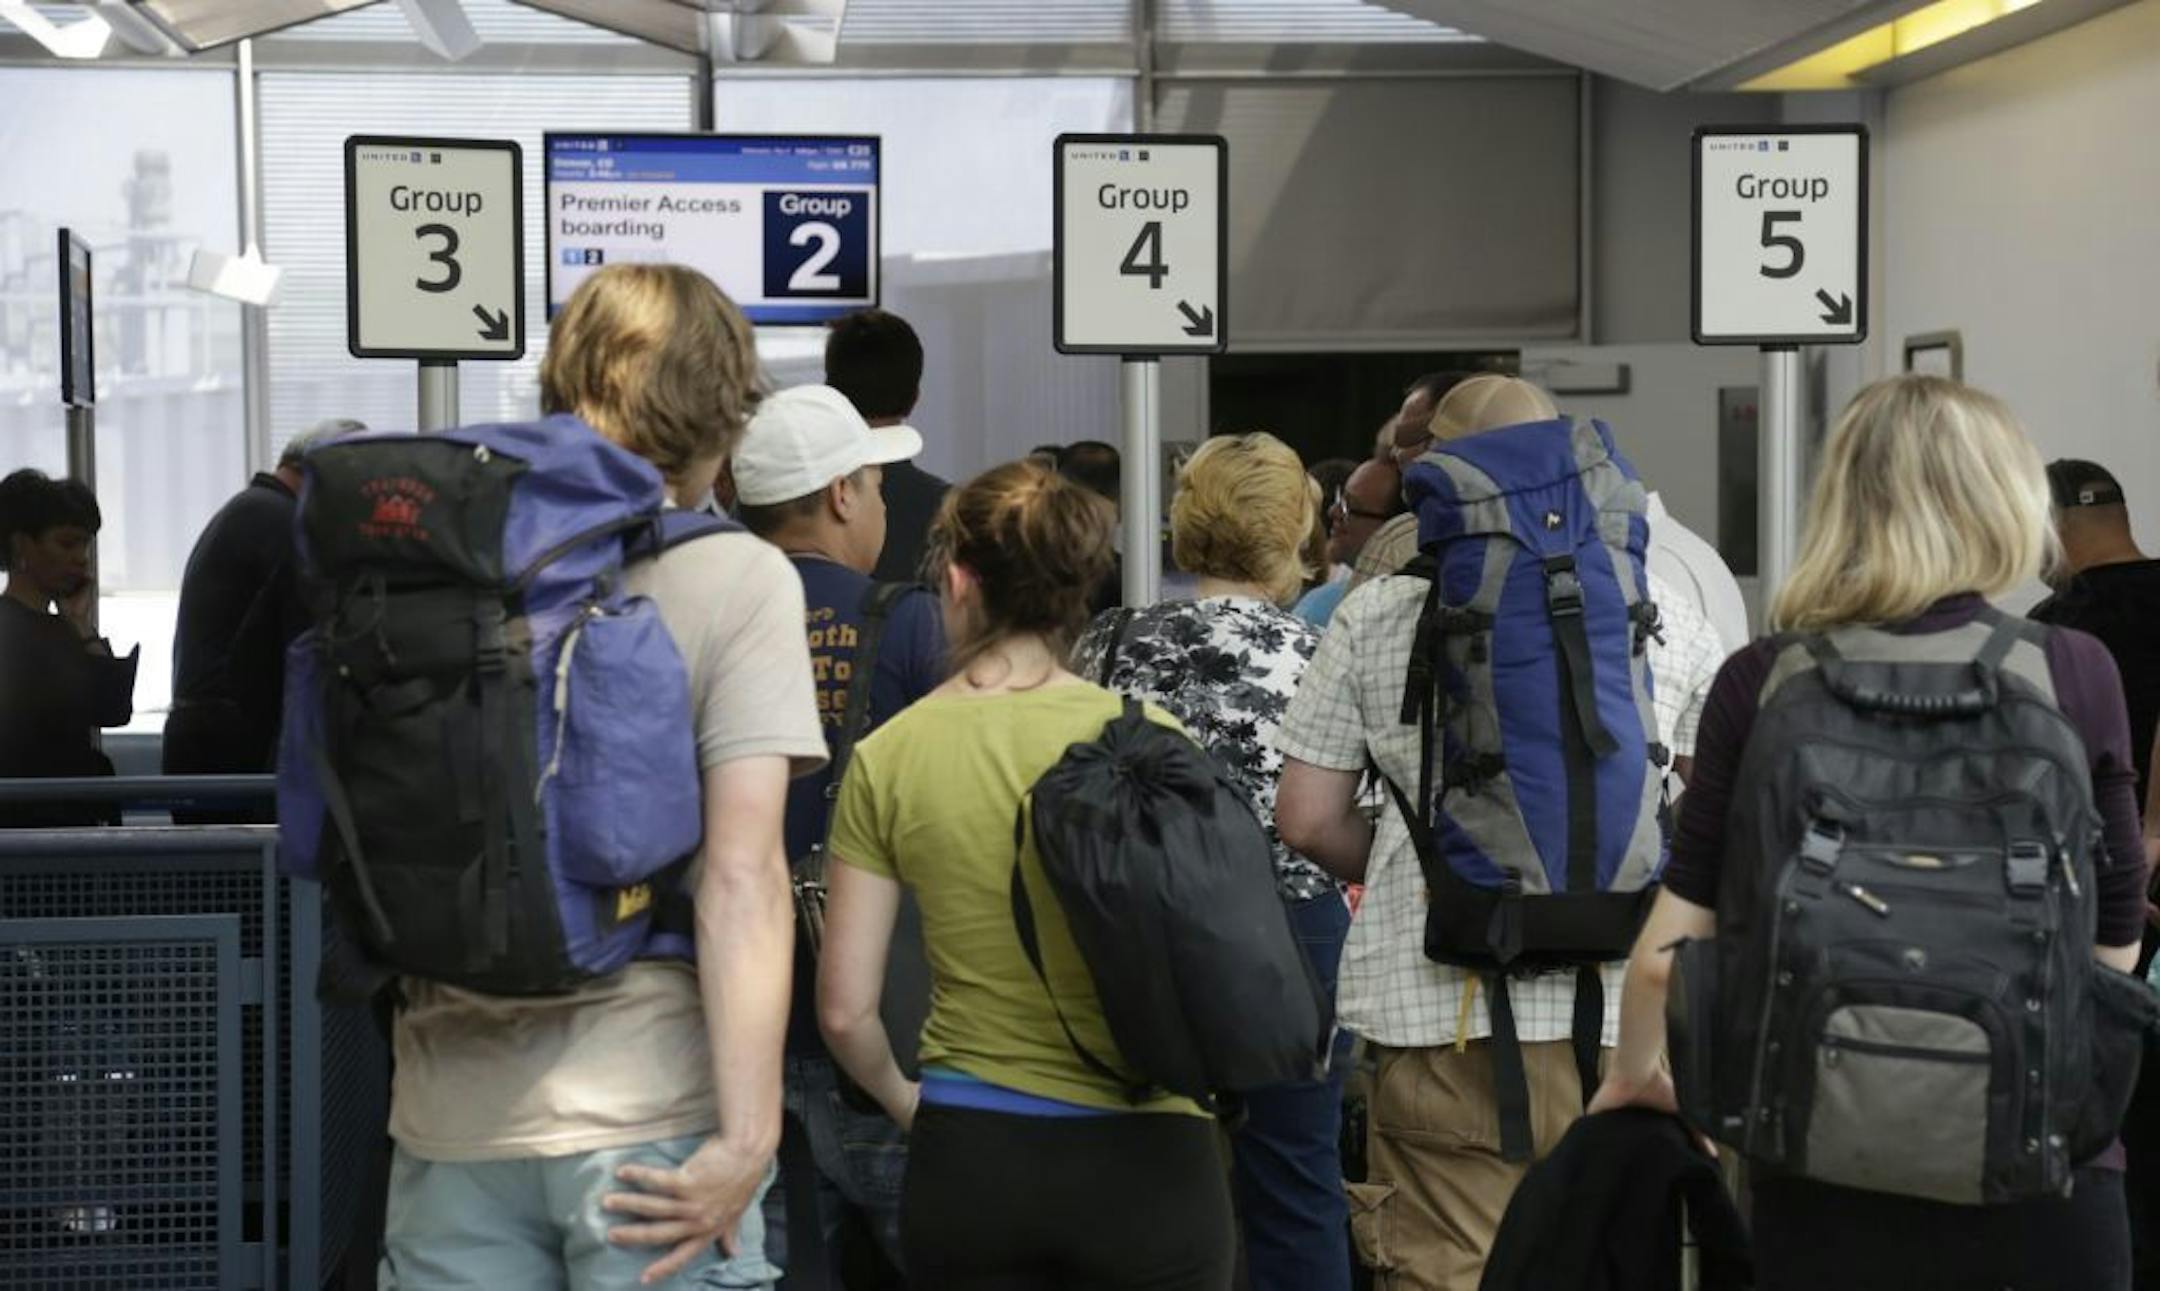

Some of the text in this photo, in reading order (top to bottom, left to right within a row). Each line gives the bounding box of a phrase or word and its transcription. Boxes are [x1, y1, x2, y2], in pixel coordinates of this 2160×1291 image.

[362, 153, 407, 162] UNITED
[390, 185, 483, 218] Group
[560, 193, 742, 213] Premier Access
[1098, 183, 1189, 214] Group
[1736, 173, 1829, 203] Group
[779, 193, 852, 219] Group
[560, 219, 665, 240] boarding
[1759, 210, 1806, 279] 5
[415, 222, 462, 294] 3
[787, 220, 842, 291] 2
[1119, 221, 1169, 290] 4
